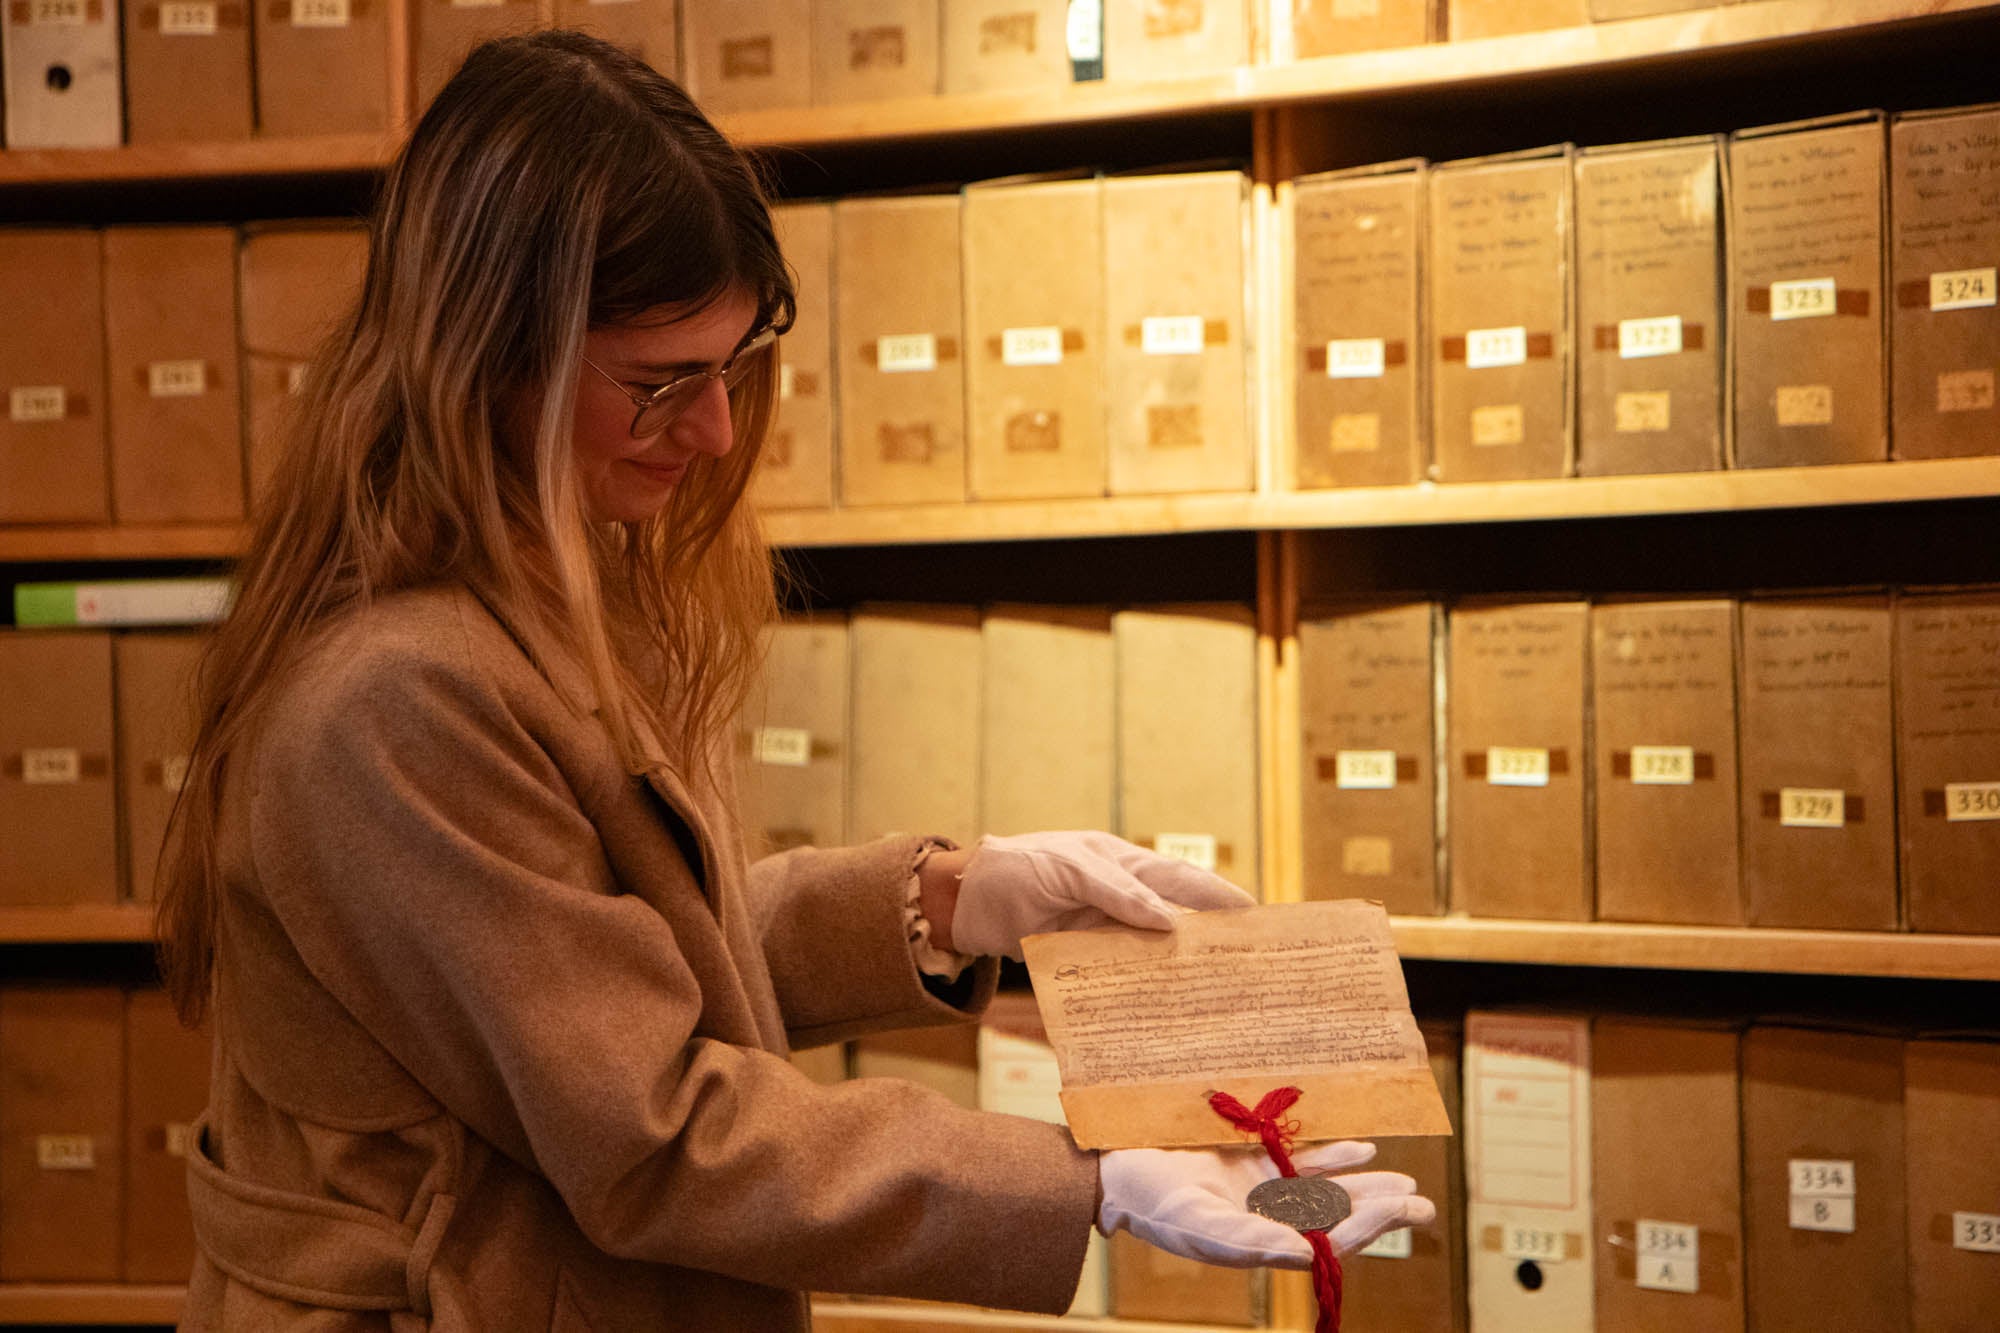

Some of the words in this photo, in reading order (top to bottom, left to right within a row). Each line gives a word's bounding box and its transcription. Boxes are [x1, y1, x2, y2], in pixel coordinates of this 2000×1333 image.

[1784, 288, 1824, 311] 323
[1942, 278, 1984, 300] 324
[1794, 796, 1833, 817] 329
[1957, 788, 2000, 812] 330
[1800, 1167, 1844, 1189] 334
[1814, 1200, 1831, 1223] B
[1649, 1227, 1689, 1250] 334
[1657, 1262, 1676, 1283] A
